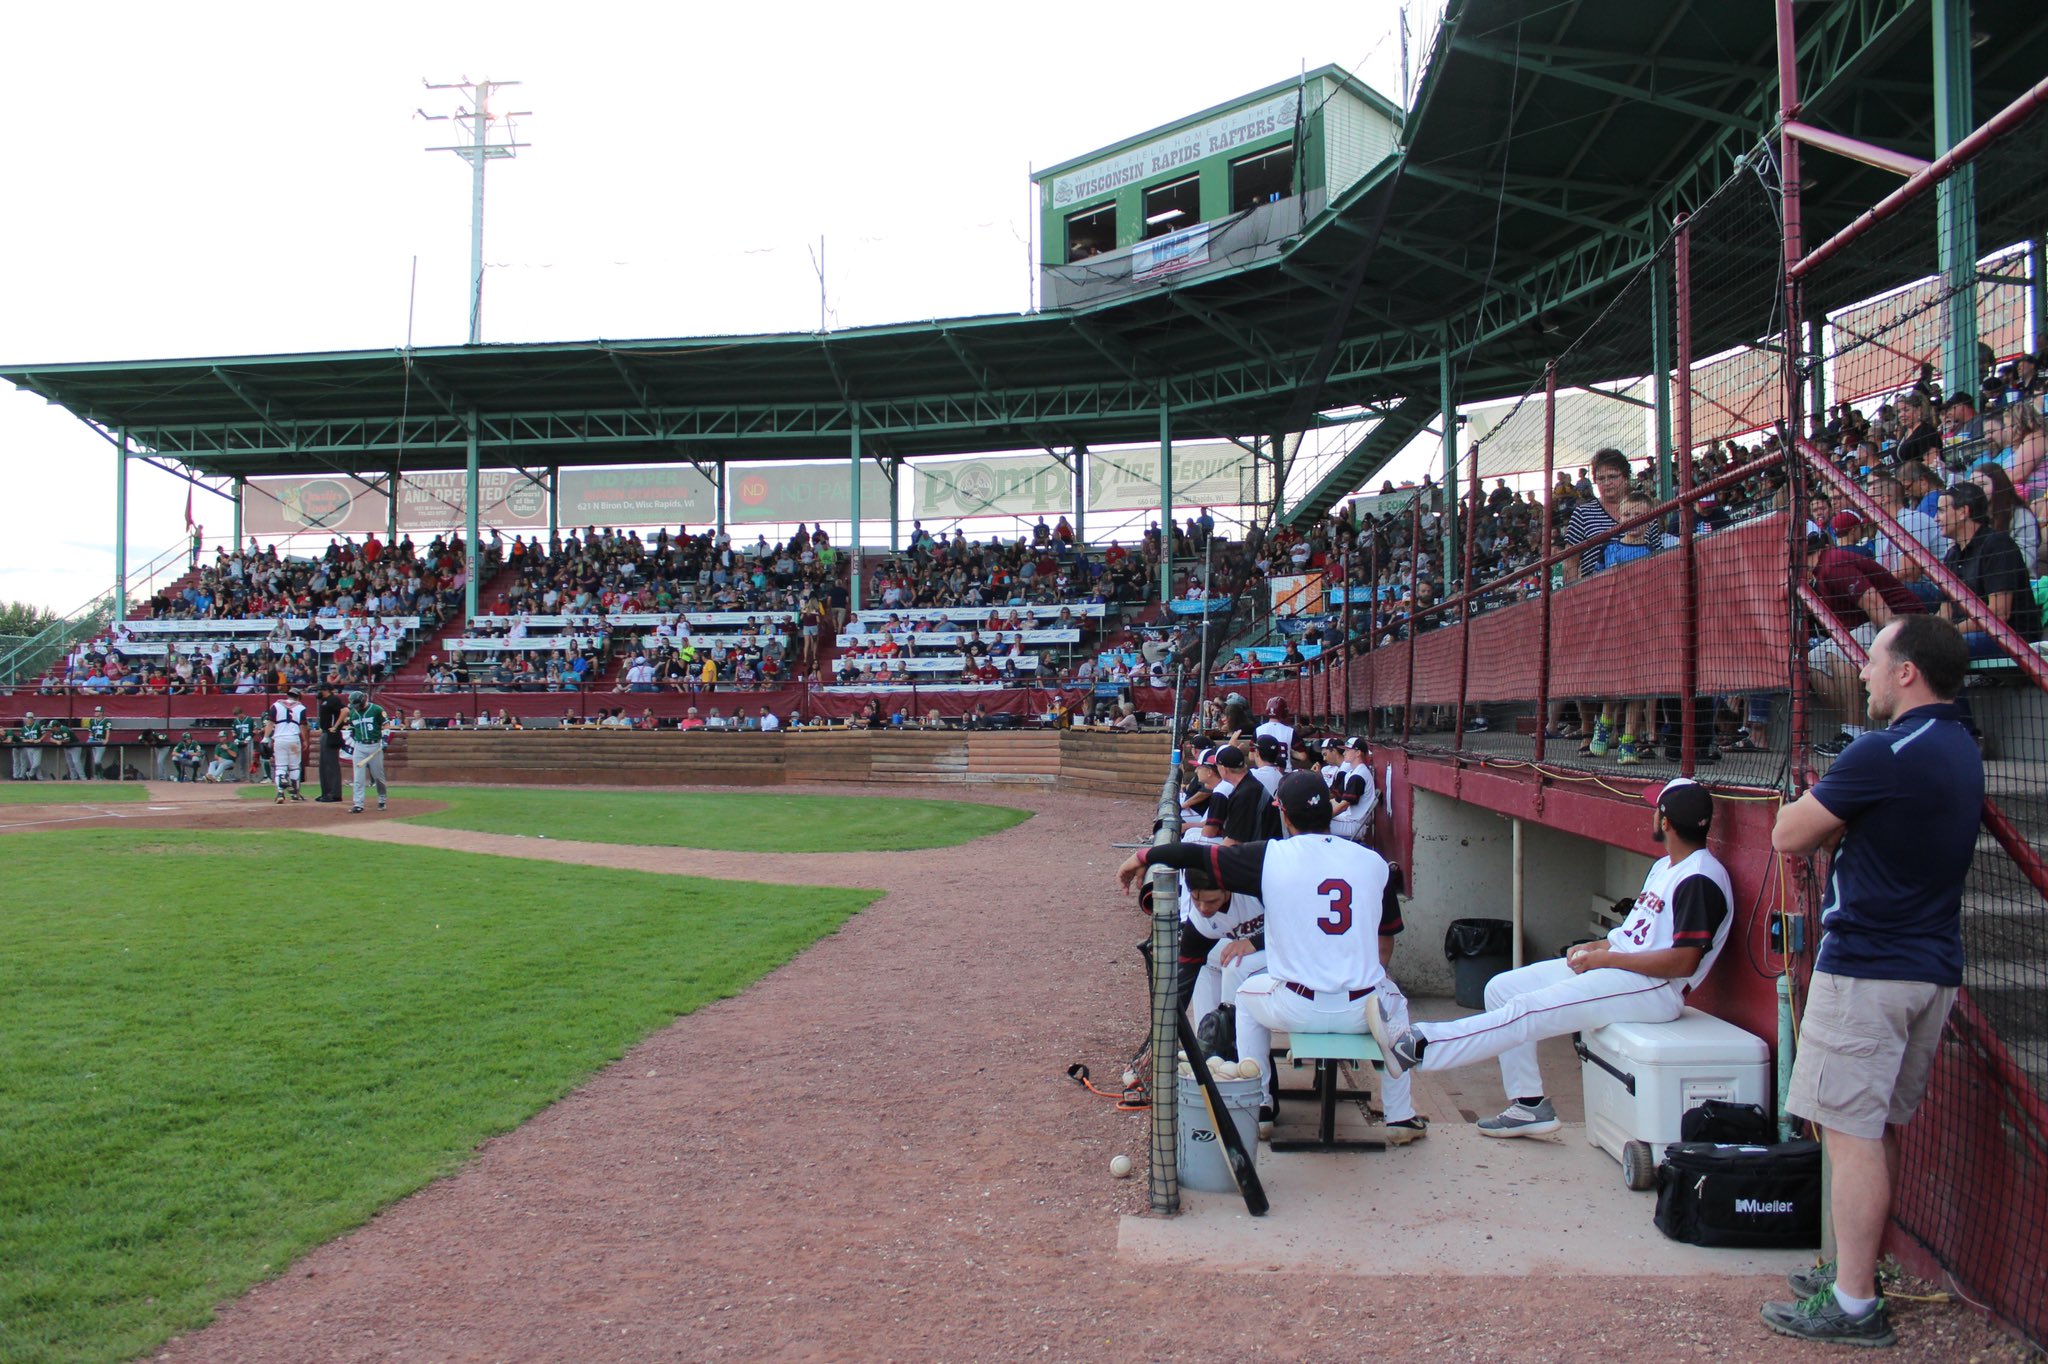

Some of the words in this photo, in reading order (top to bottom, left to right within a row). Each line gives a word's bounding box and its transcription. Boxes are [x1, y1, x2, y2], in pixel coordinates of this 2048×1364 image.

[1074, 161, 1120, 182] WITTER
[1128, 145, 1165, 164] FIELD
[1174, 128, 1213, 147] HOME
[1220, 117, 1238, 131] OF
[1247, 105, 1274, 121] THE
[1074, 162, 1144, 199] WISCONSIN
[1151, 142, 1201, 173] RAPIDS
[1208, 115, 1276, 153] RAFTERS
[592, 473, 617, 487] ND
[623, 471, 679, 486] PAPER
[1112, 457, 1155, 484] TIRE
[400, 473, 461, 489] LOCALLY
[404, 489, 430, 504] AND
[434, 487, 503, 503] OPERTED
[743, 483, 765, 497] ND
[780, 484, 811, 504] ND
[577, 502, 591, 511] 621
[592, 502, 600, 510] N
[600, 501, 622, 510] Biron
[636, 500, 653, 509] Wisc
[684, 499, 695, 507] WI
[1317, 878, 1352, 935] 3
[1745, 1199, 1793, 1213] Mueller
